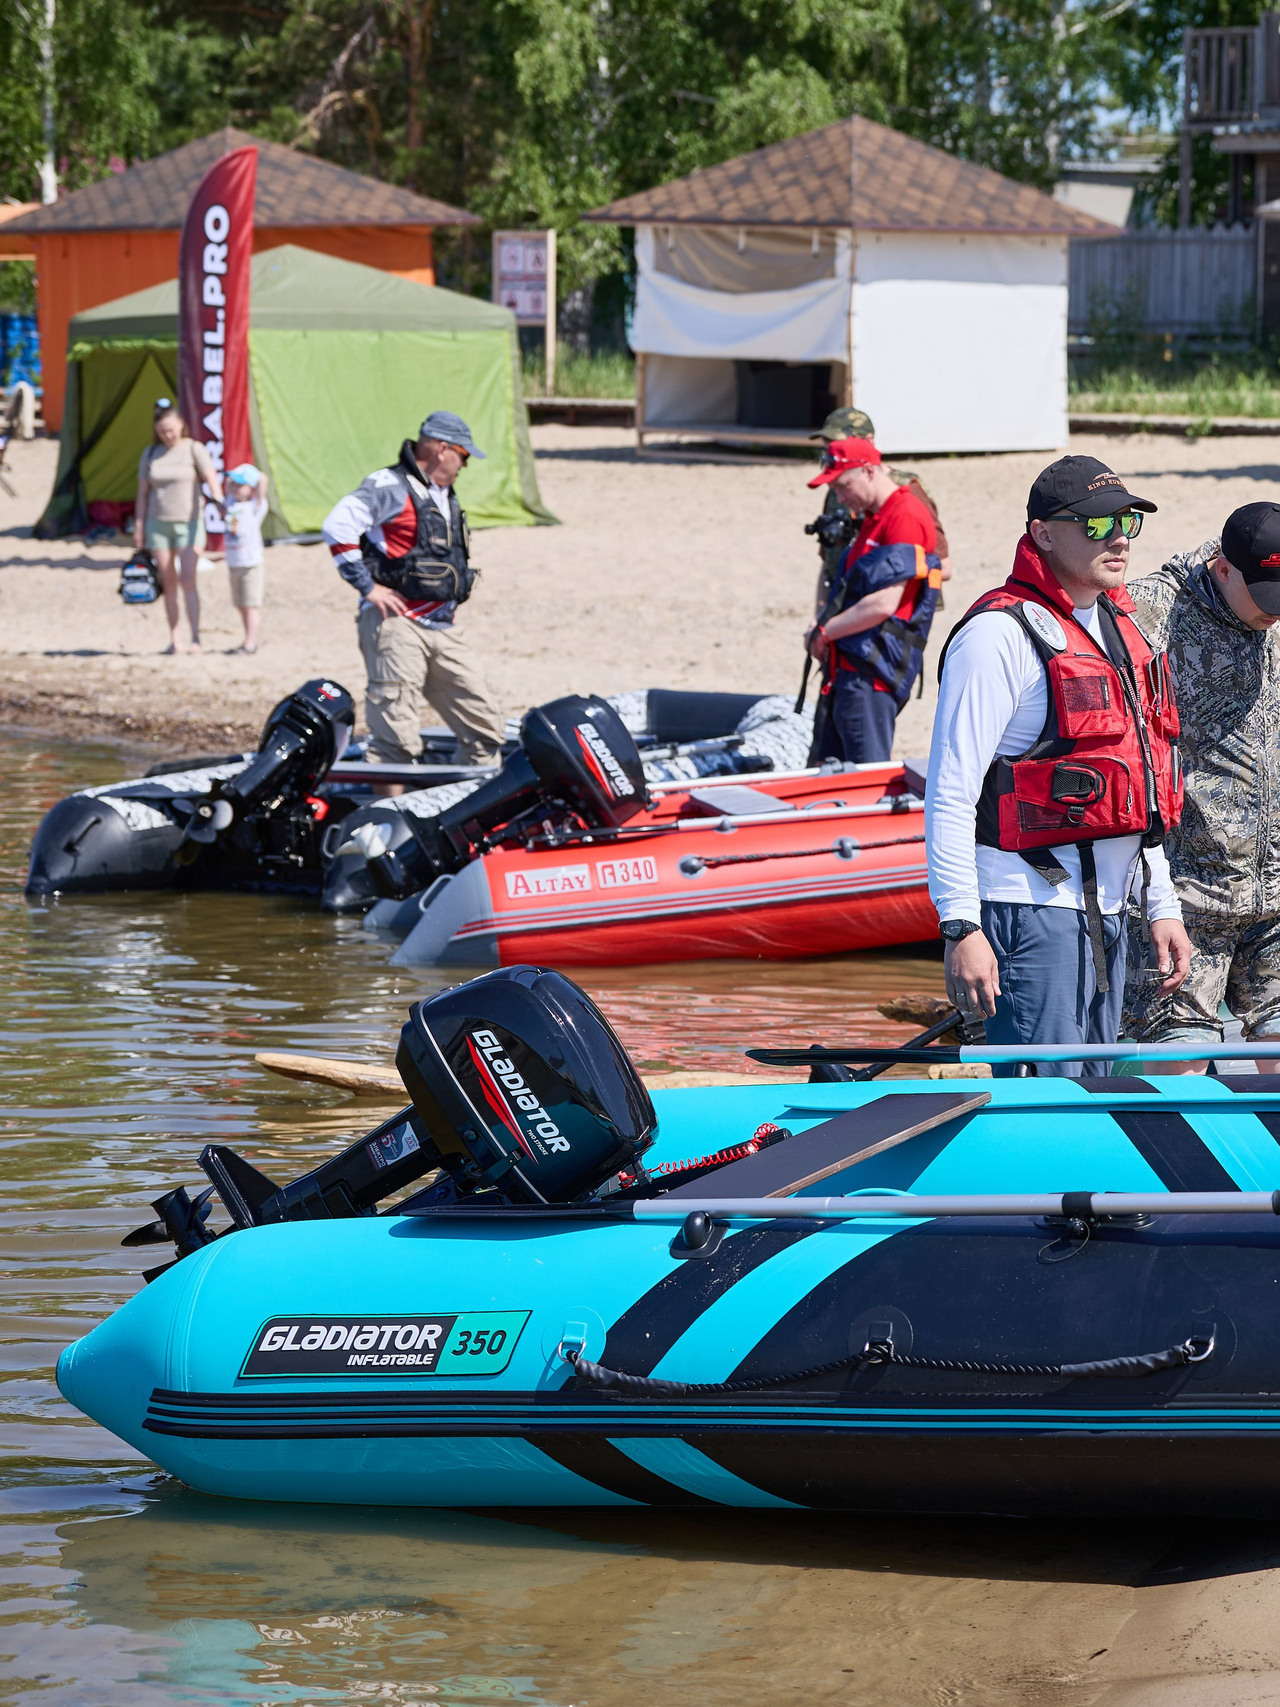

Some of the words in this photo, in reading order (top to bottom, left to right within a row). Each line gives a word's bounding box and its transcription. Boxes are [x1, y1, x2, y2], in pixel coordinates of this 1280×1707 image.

[512, 874, 586, 895] ALTAY
[472, 1029, 571, 1153] GLADIATOR
[526, 1129, 537, 1140] TWO
[534, 1138, 550, 1156] STROKE
[258, 1324, 443, 1352] GLADIATOR
[451, 1330, 507, 1356] 350
[346, 1353, 435, 1367] INFLATABLE
